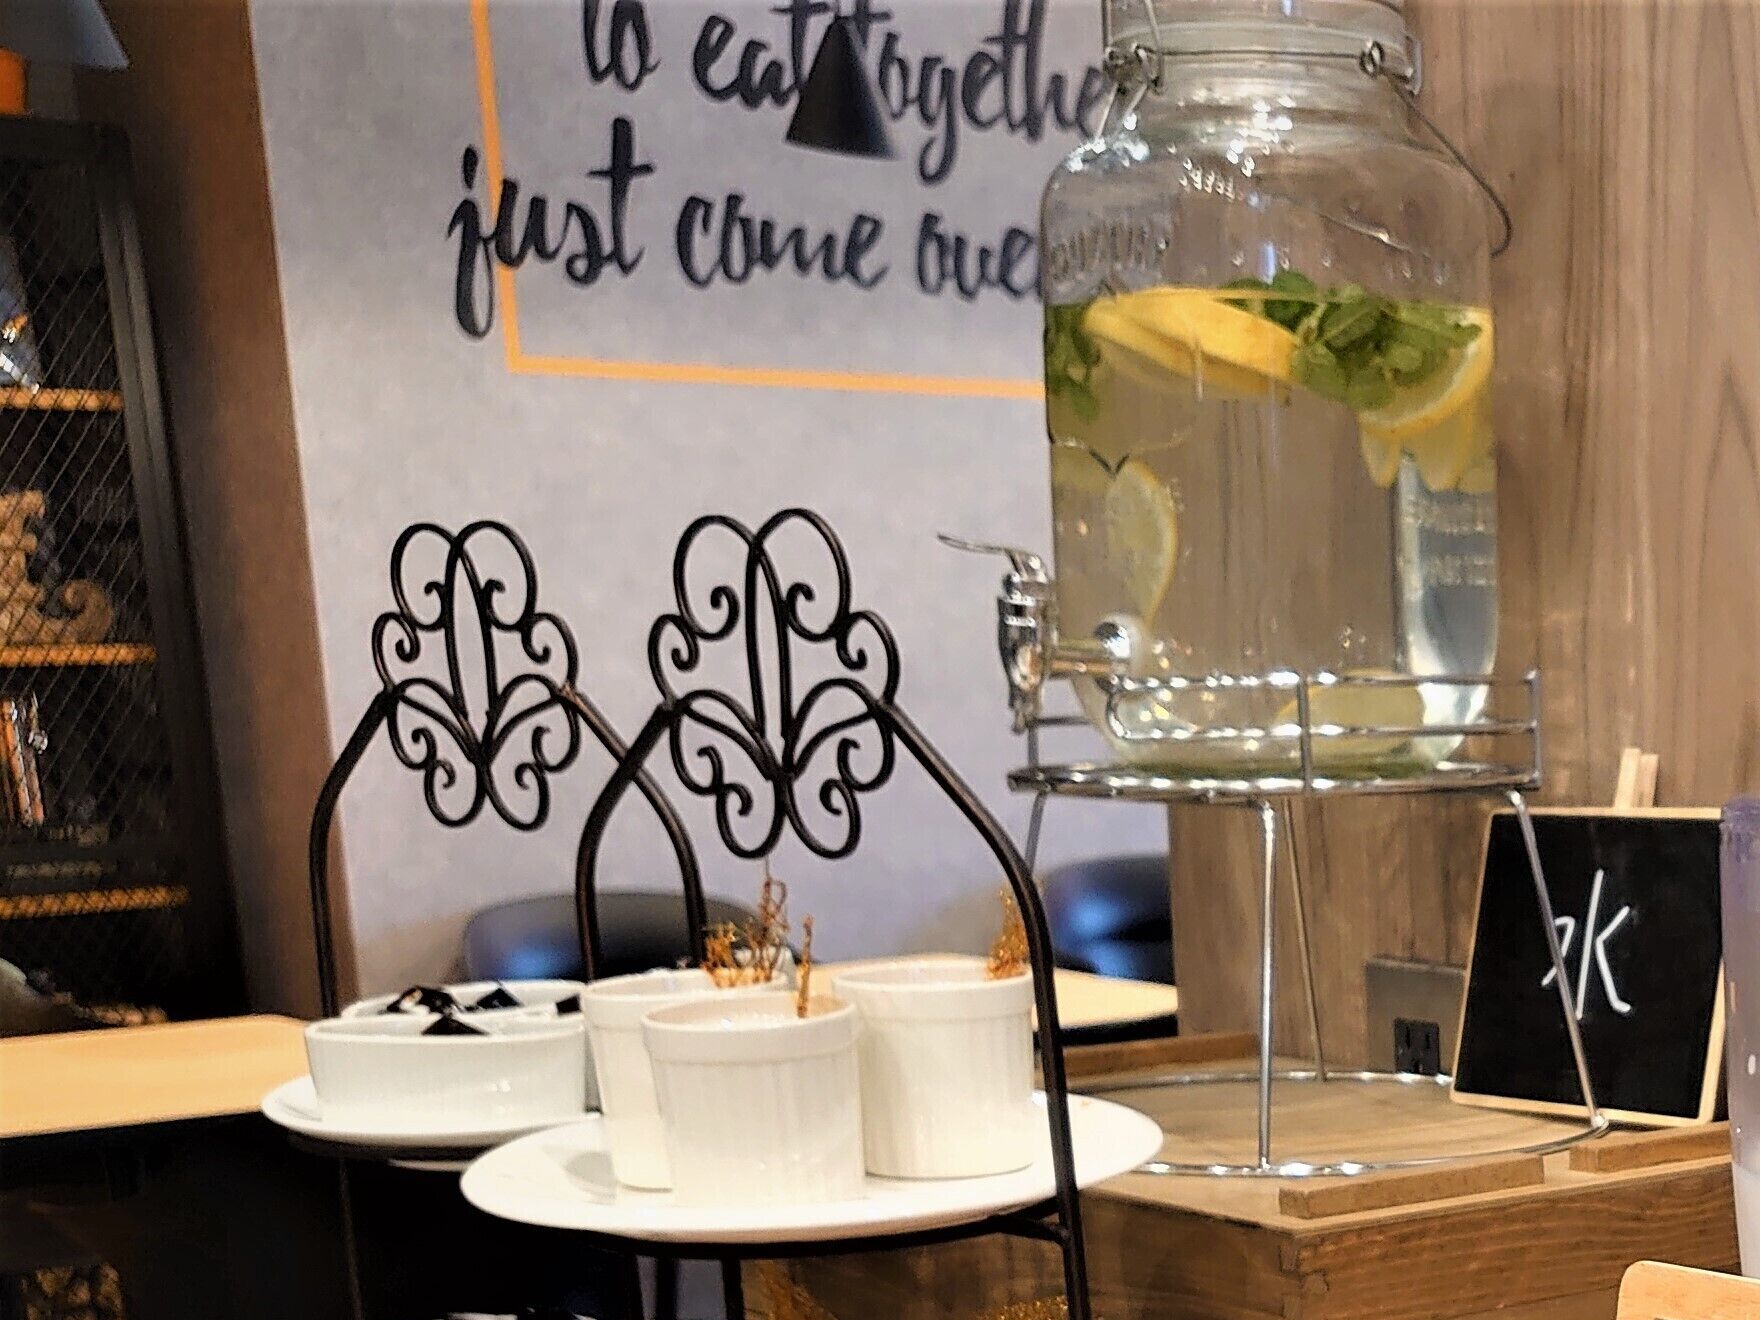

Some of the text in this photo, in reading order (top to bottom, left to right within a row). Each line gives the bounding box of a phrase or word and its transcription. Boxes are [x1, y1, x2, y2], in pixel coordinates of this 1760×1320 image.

[447, 116, 656, 339] just
[676, 193, 888, 291] come
[915, 211, 1042, 300] ove
